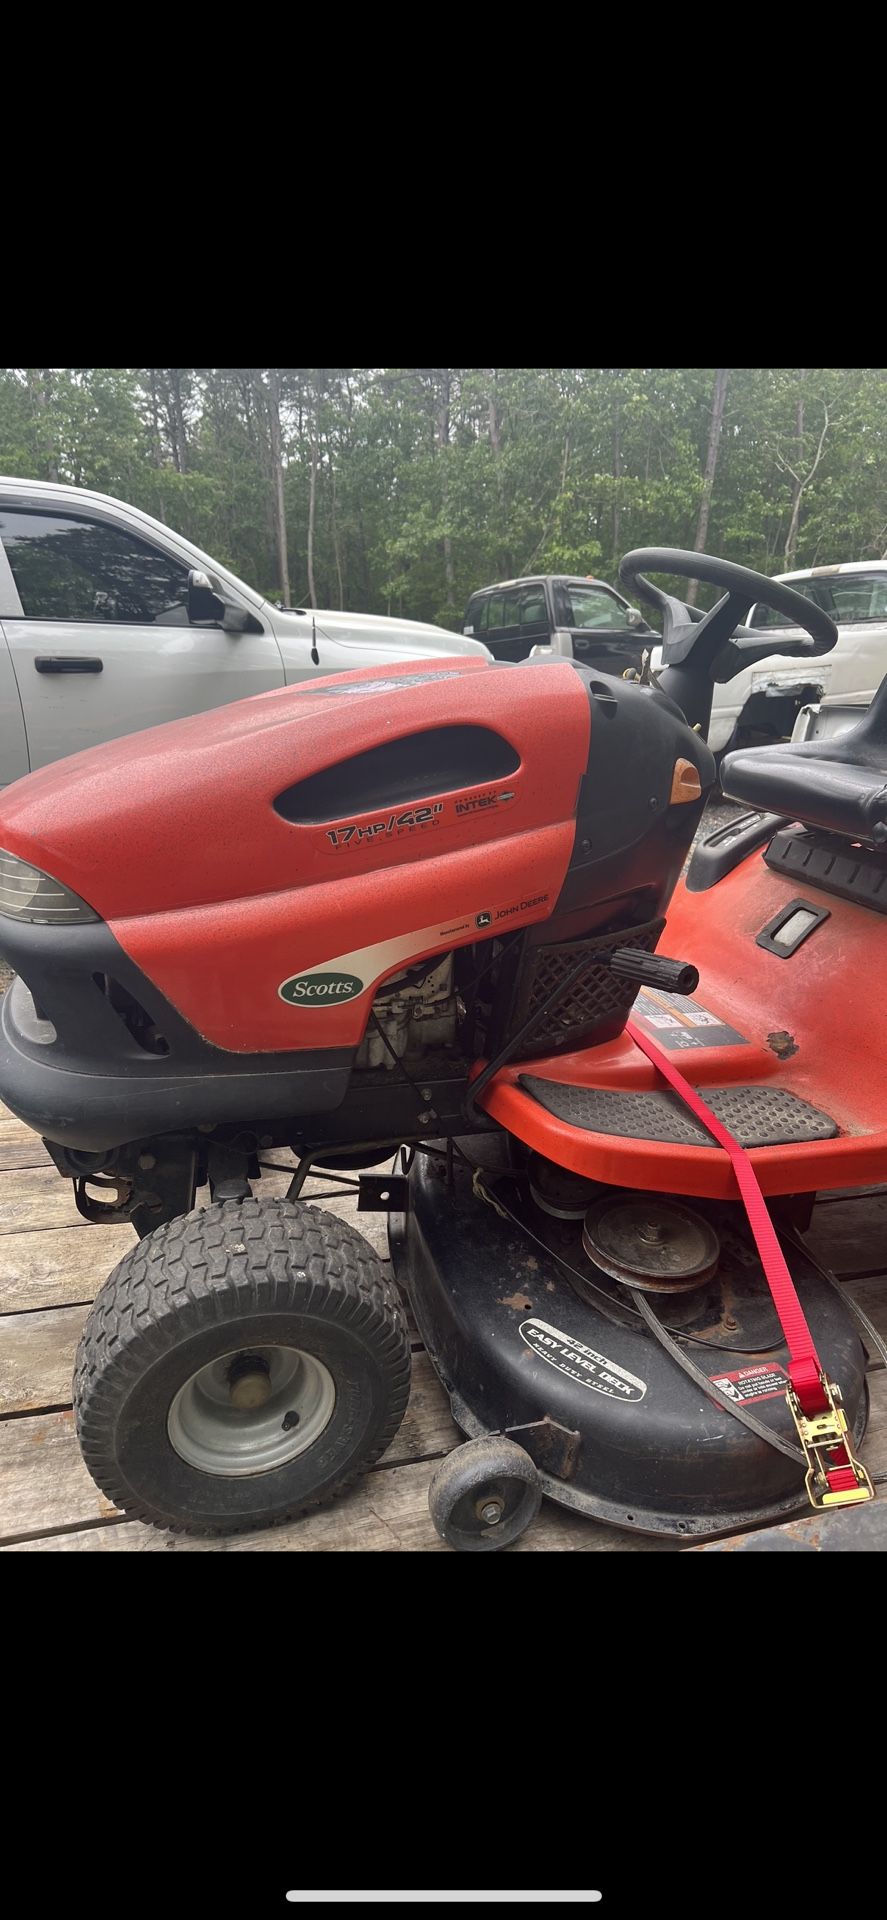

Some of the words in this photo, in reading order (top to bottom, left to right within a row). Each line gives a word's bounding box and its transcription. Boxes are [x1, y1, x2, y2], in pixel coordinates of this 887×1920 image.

[456, 795, 496, 813] INTEK
[494, 905, 519, 920] JOHN
[520, 894, 550, 910] DEERE
[526, 1328, 563, 1349] EASY
[560, 1348, 596, 1374] LEVEL
[598, 1371, 636, 1395] DECK
[566, 1337, 584, 1349] 42
[584, 1346, 608, 1366] inch
[532, 1343, 558, 1362] HEAVY
[559, 1362, 583, 1378] DUTY
[584, 1378, 615, 1394] STEEL
[744, 1366, 768, 1376] DANGER
